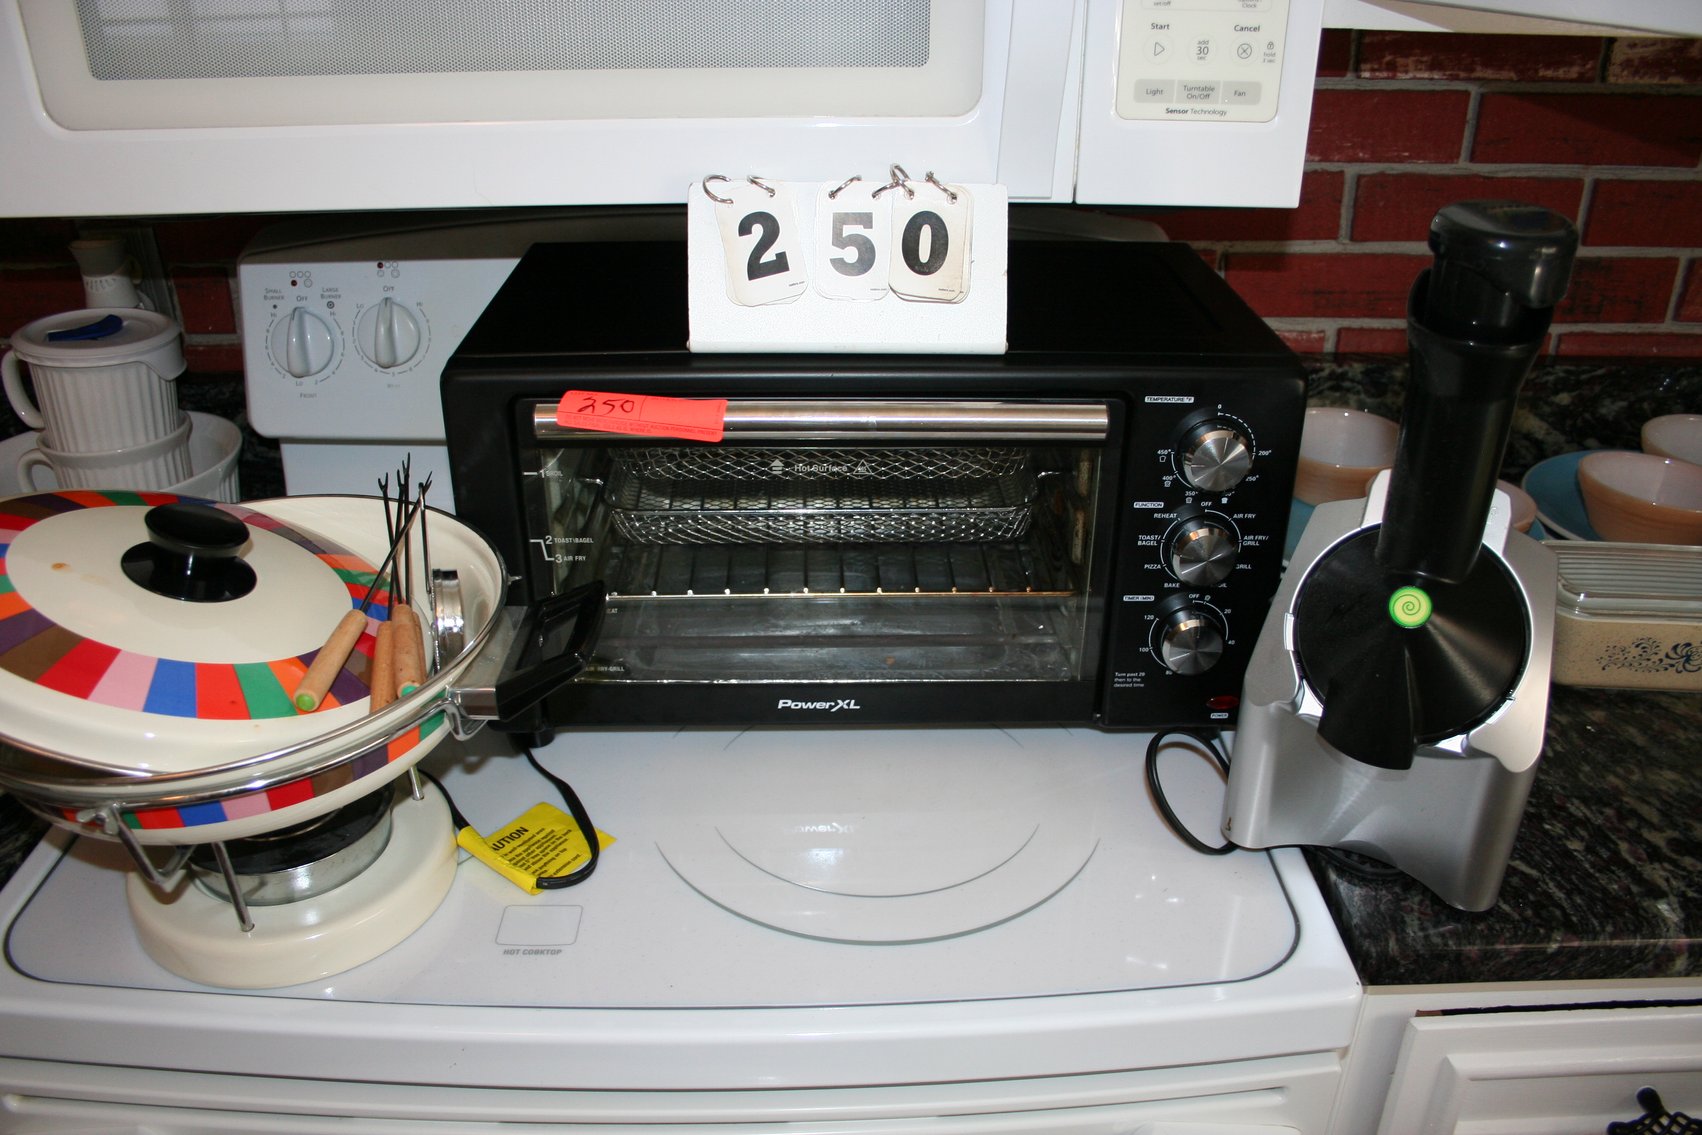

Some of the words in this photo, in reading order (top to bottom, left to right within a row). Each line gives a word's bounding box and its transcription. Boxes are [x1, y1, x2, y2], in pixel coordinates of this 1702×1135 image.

[1151, 22, 1170, 30] Start
[1234, 24, 1260, 32] Cancel
[1196, 46, 1209, 56] 30
[1146, 88, 1163, 96] Light
[1183, 84, 1215, 92] Turntable
[1165, 107, 1189, 115] Sensor
[1190, 108, 1227, 117] Technology
[577, 396, 635, 416] 250
[794, 464, 810, 472] Hot
[812, 464, 848, 472] Surface
[545, 535, 552, 545] 2
[555, 554, 563, 563] 3
[777, 699, 861, 712] PowerXL
